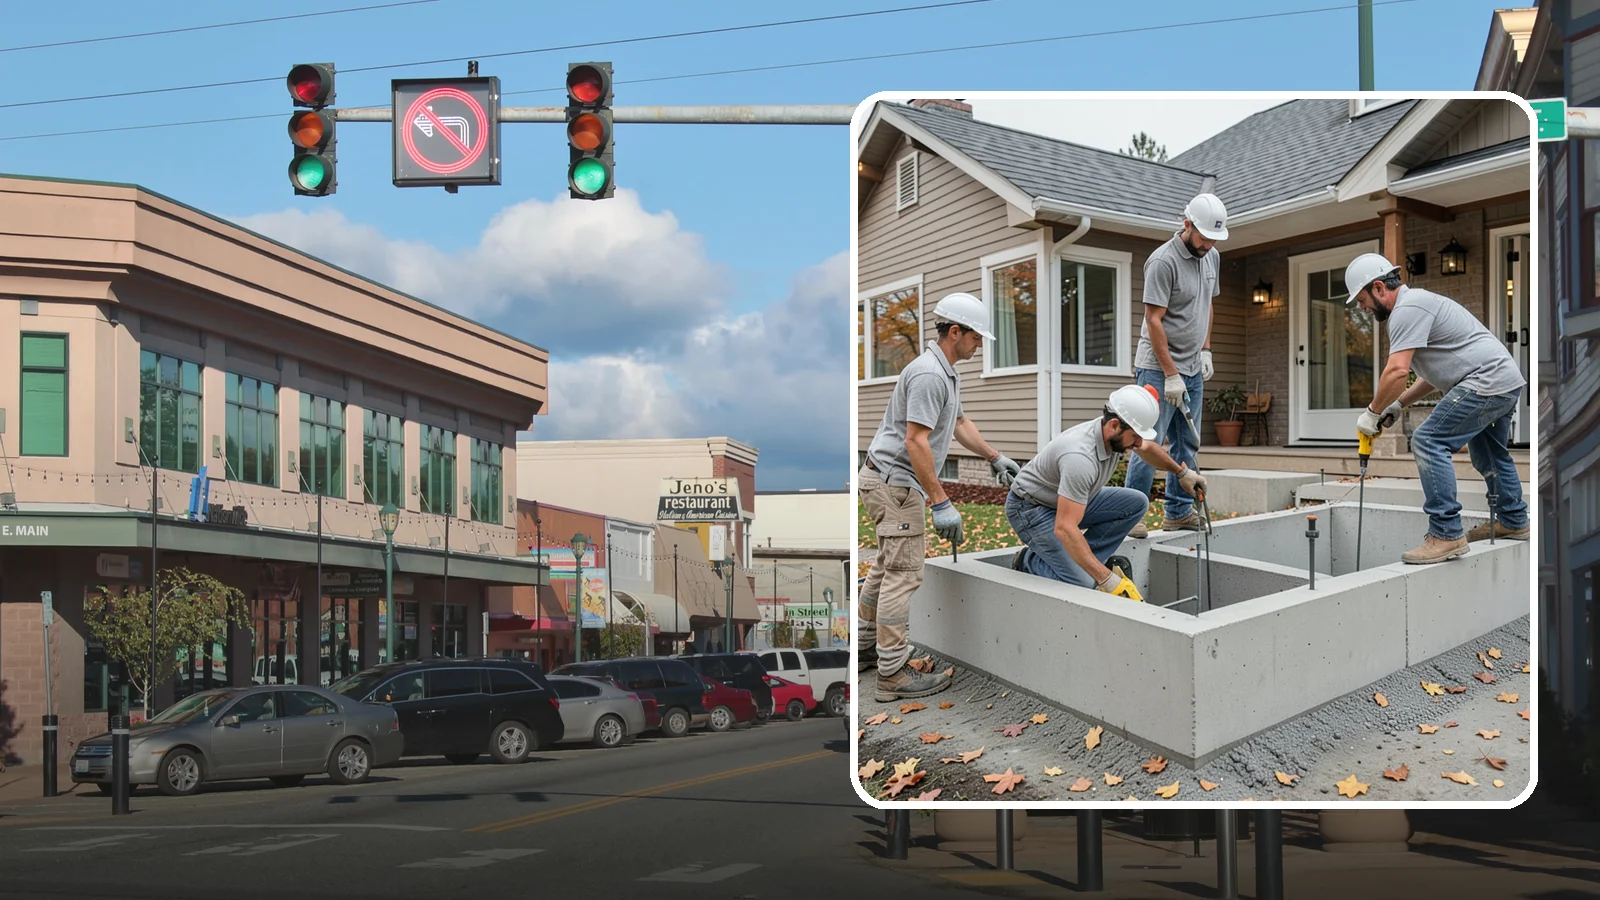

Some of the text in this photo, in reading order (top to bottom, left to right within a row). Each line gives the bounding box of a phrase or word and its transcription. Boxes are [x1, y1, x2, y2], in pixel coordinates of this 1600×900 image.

[670, 480, 727, 494] Jeno's
[665, 496, 731, 509] restaurant
[659, 510, 681, 519] Italian
[686, 510, 714, 519] American
[715, 510, 737, 519] Cuisine
[2, 525, 49, 536] E. MAIN
[797, 607, 828, 616] Street
[791, 619, 824, 627] lass
